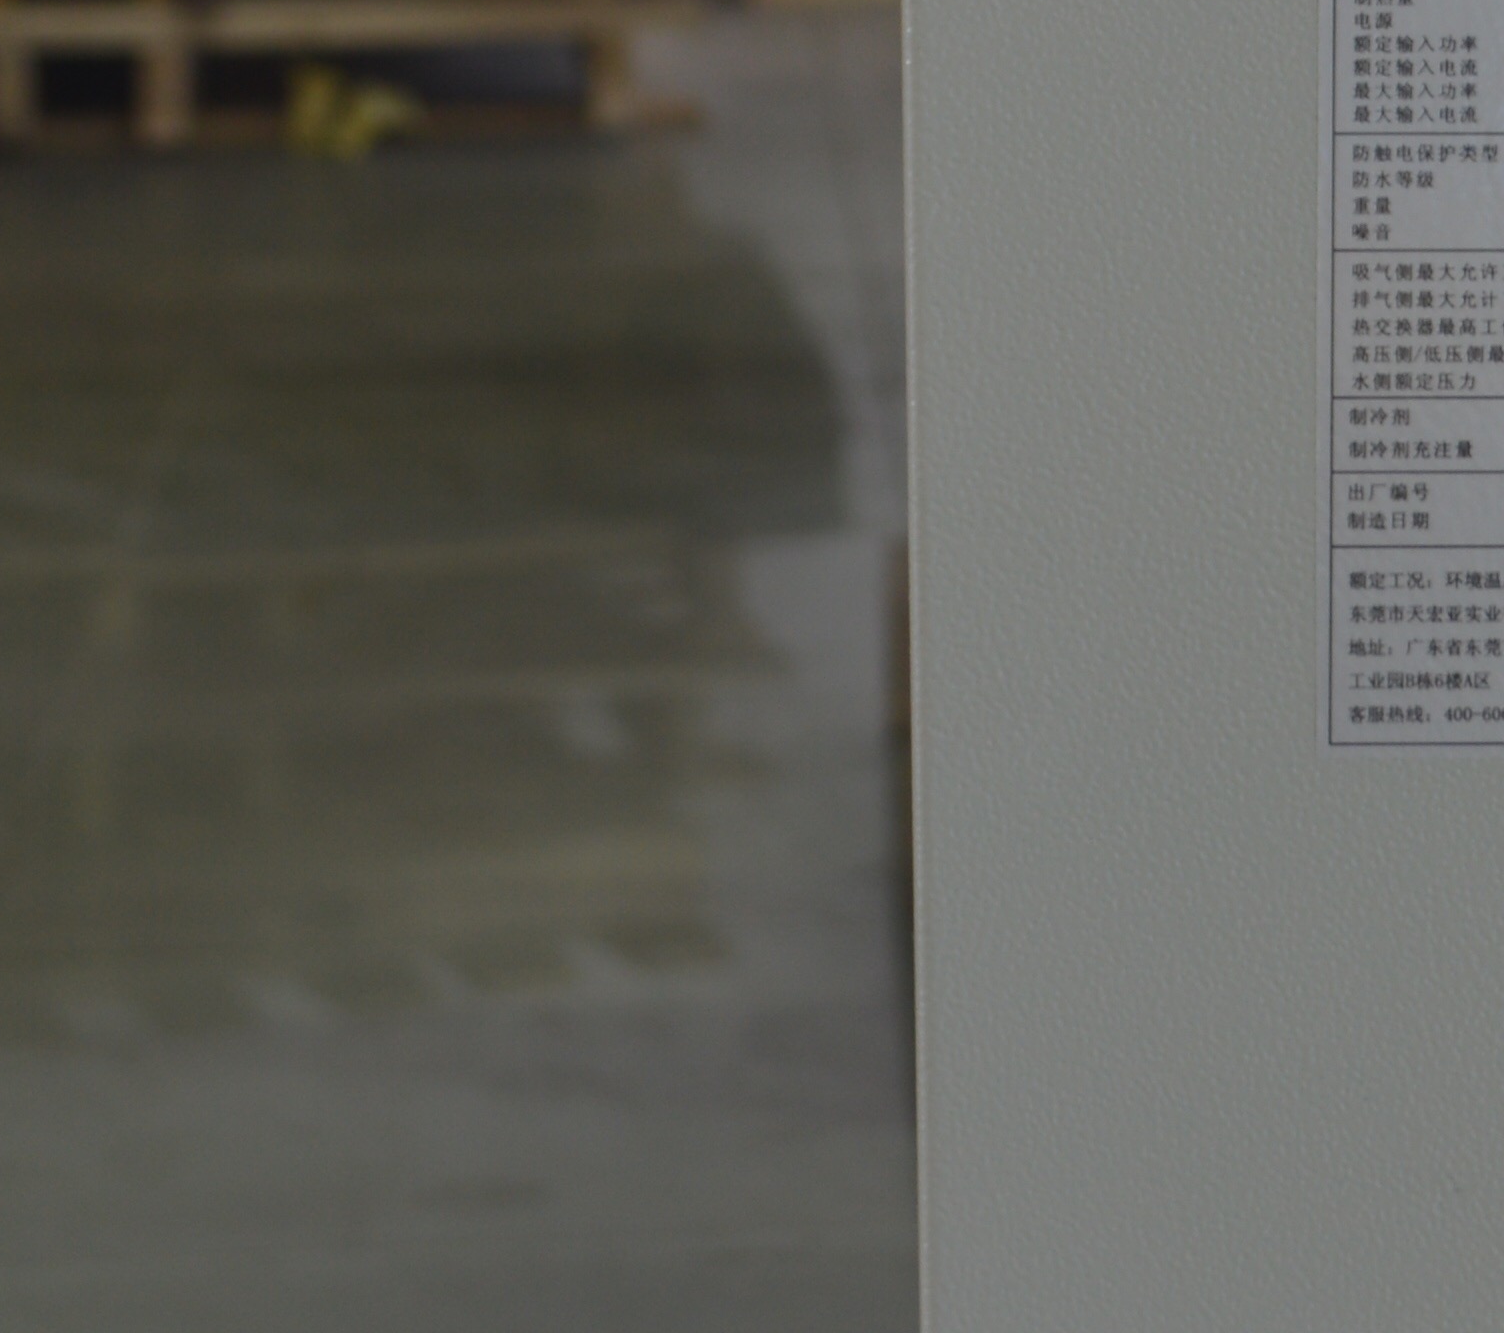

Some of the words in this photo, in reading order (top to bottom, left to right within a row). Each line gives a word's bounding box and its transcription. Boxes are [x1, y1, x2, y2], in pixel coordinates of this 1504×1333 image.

[1354, 12, 1393, 30] 电源
[1353, 35, 1477, 54] 额定输入功率
[1353, 58, 1478, 77] 额定输入电流
[1353, 81, 1477, 101] 最大输入功率
[1353, 105, 1477, 124] 最大输入电流
[1352, 144, 1498, 163] 防触电保护类型
[1352, 170, 1434, 189] 防水等级
[1354, 196, 1391, 215] 重量
[1351, 223, 1390, 241] 噪音
[1353, 372, 1476, 392] 水侧额定压力
[1348, 407, 1410, 427] 制冷剂
[1348, 440, 1473, 459] 制冷剂充注量
[1348, 482, 1429, 502] 出厂编号
[1347, 511, 1430, 531] 制造日期
[1349, 671, 1489, 691] 工业园B栋6楼A区
